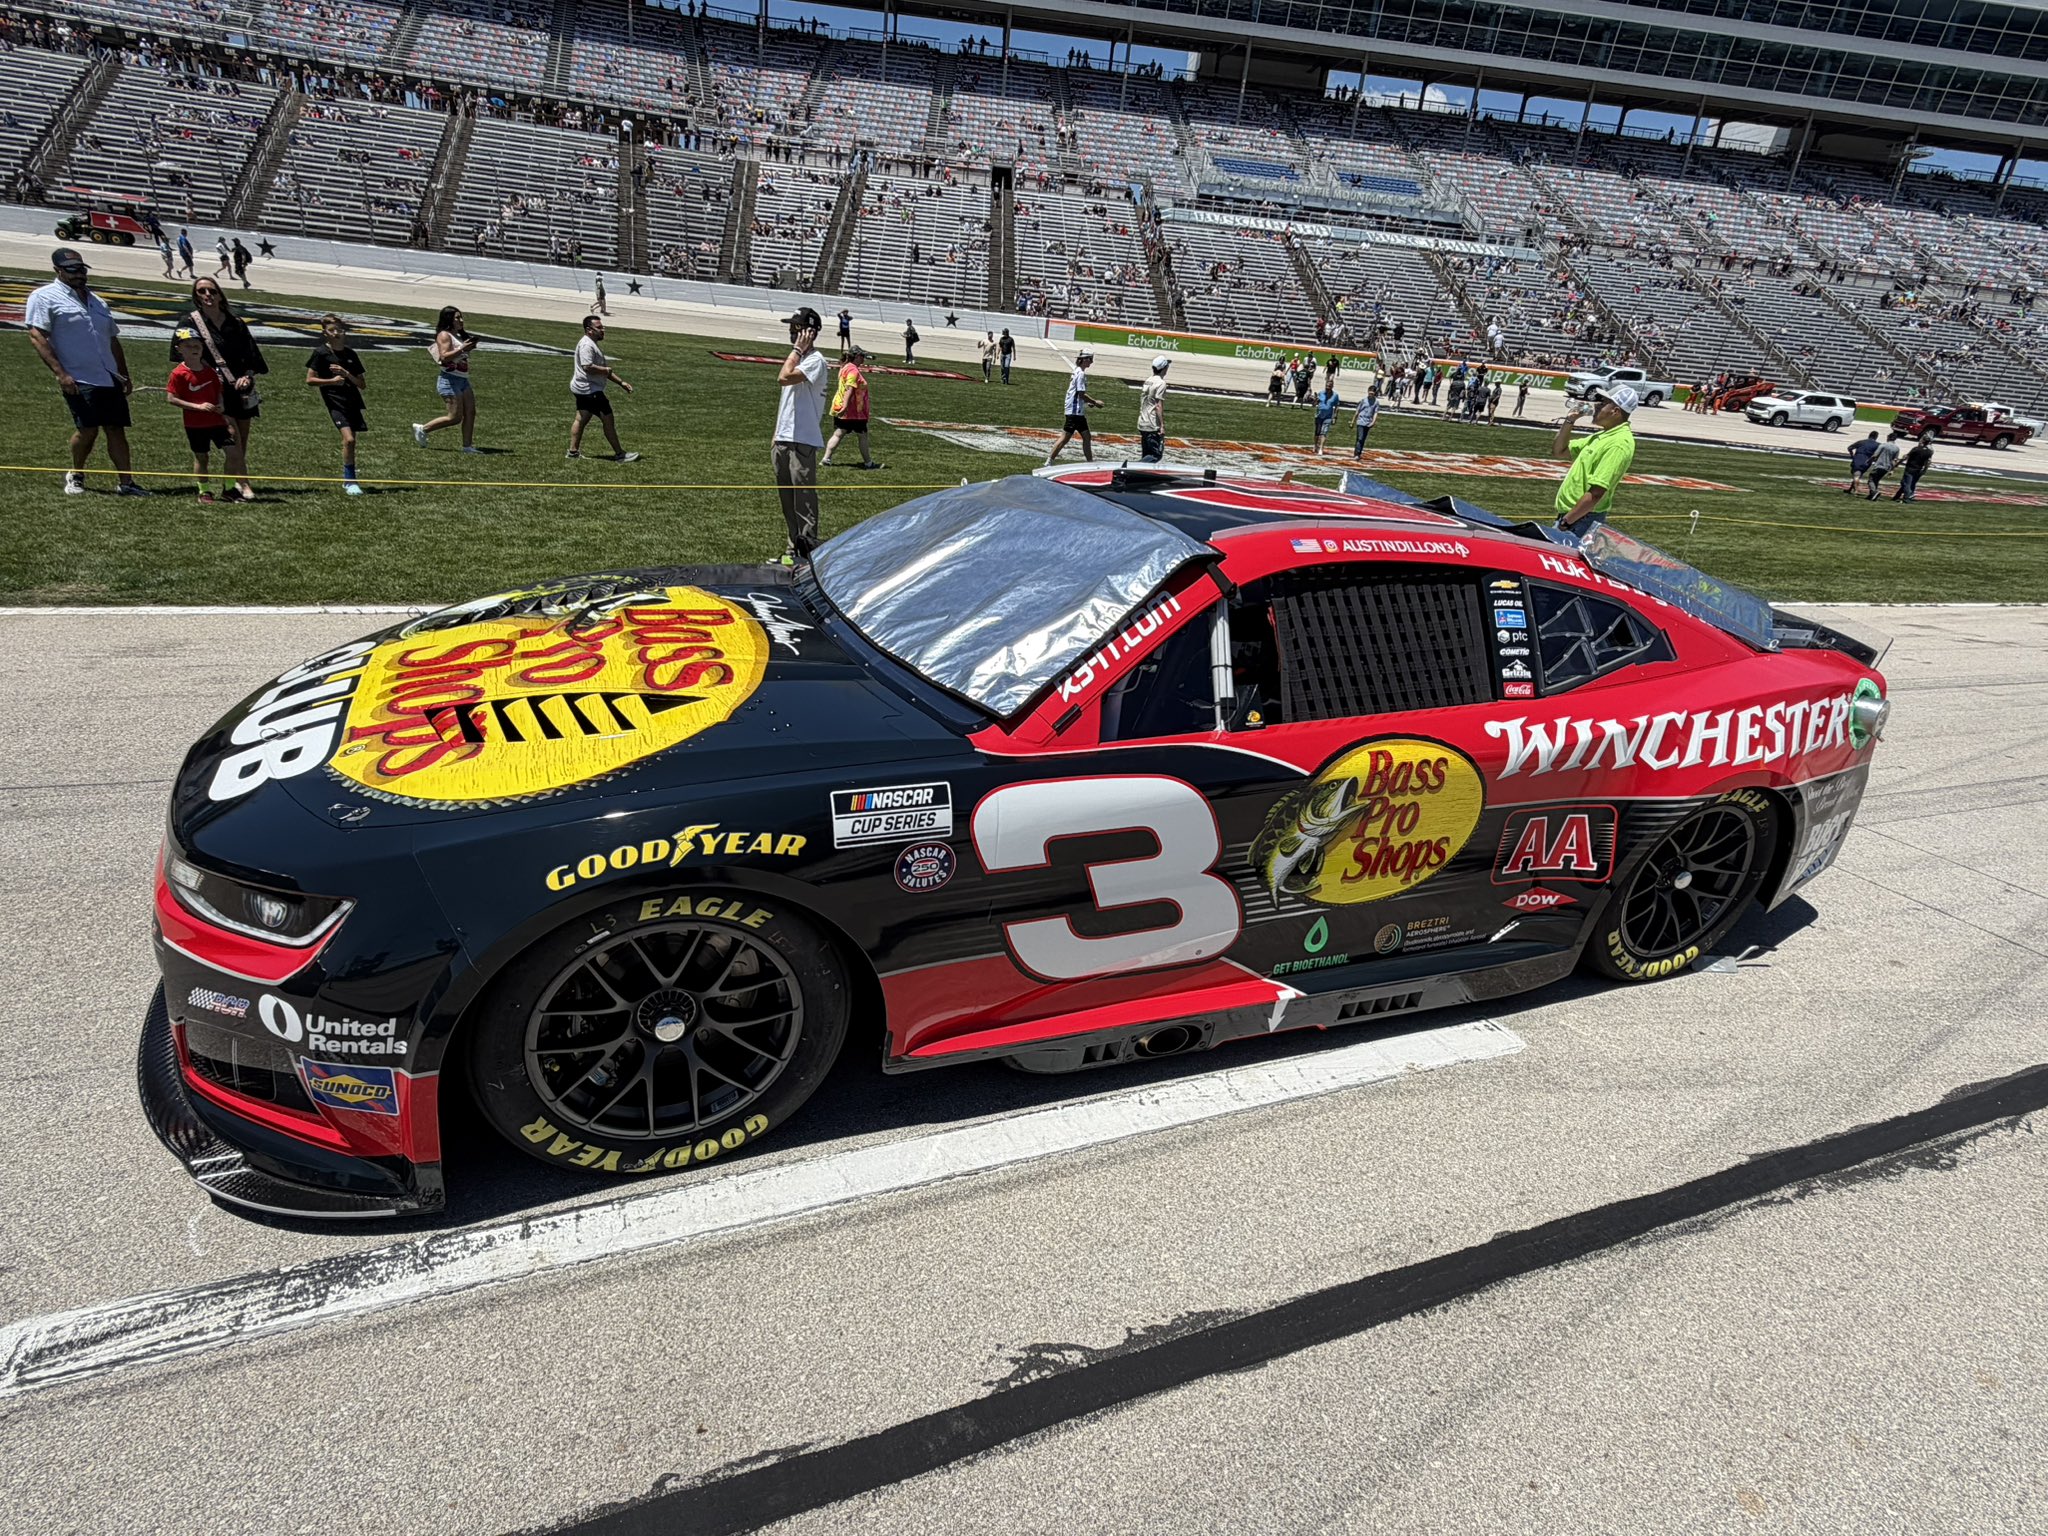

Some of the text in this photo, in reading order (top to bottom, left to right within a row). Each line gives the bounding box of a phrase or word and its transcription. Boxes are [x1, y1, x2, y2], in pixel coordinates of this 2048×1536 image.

[1128, 333, 1179, 351] EchoPark
[1511, 372, 1555, 388] ZONE
[1342, 539, 1454, 555] AUSTINDILLON3
[1494, 599, 1514, 607] LUCAS
[1512, 630, 1528, 643] ptc
[624, 608, 736, 691] Bass
[1500, 647, 1530, 657] COMETIC
[349, 638, 517, 778] Shops
[1484, 696, 1850, 781] WINCHESTER
[1358, 750, 1449, 800] Bass
[871, 788, 934, 809] NASCAR
[1717, 788, 1770, 813] EAGLE
[851, 812, 937, 835] CUP SERIES
[1350, 796, 1420, 842] Pro
[904, 846, 947, 864] NASCAR
[1502, 814, 1598, 876] AA
[912, 861, 939, 873] 250
[1341, 836, 1450, 885] Shops
[903, 868, 947, 888] SALUTES
[970, 774, 1244, 981] 3
[1515, 893, 1561, 907] DOW
[637, 895, 774, 929] EAGLE
[1407, 916, 1450, 930] BREZTRI
[1273, 953, 1349, 976] GET BIOETHANOL
[306, 1013, 397, 1037] United
[308, 1034, 408, 1055] Rentals
[312, 1077, 389, 1098] SUNOCO
